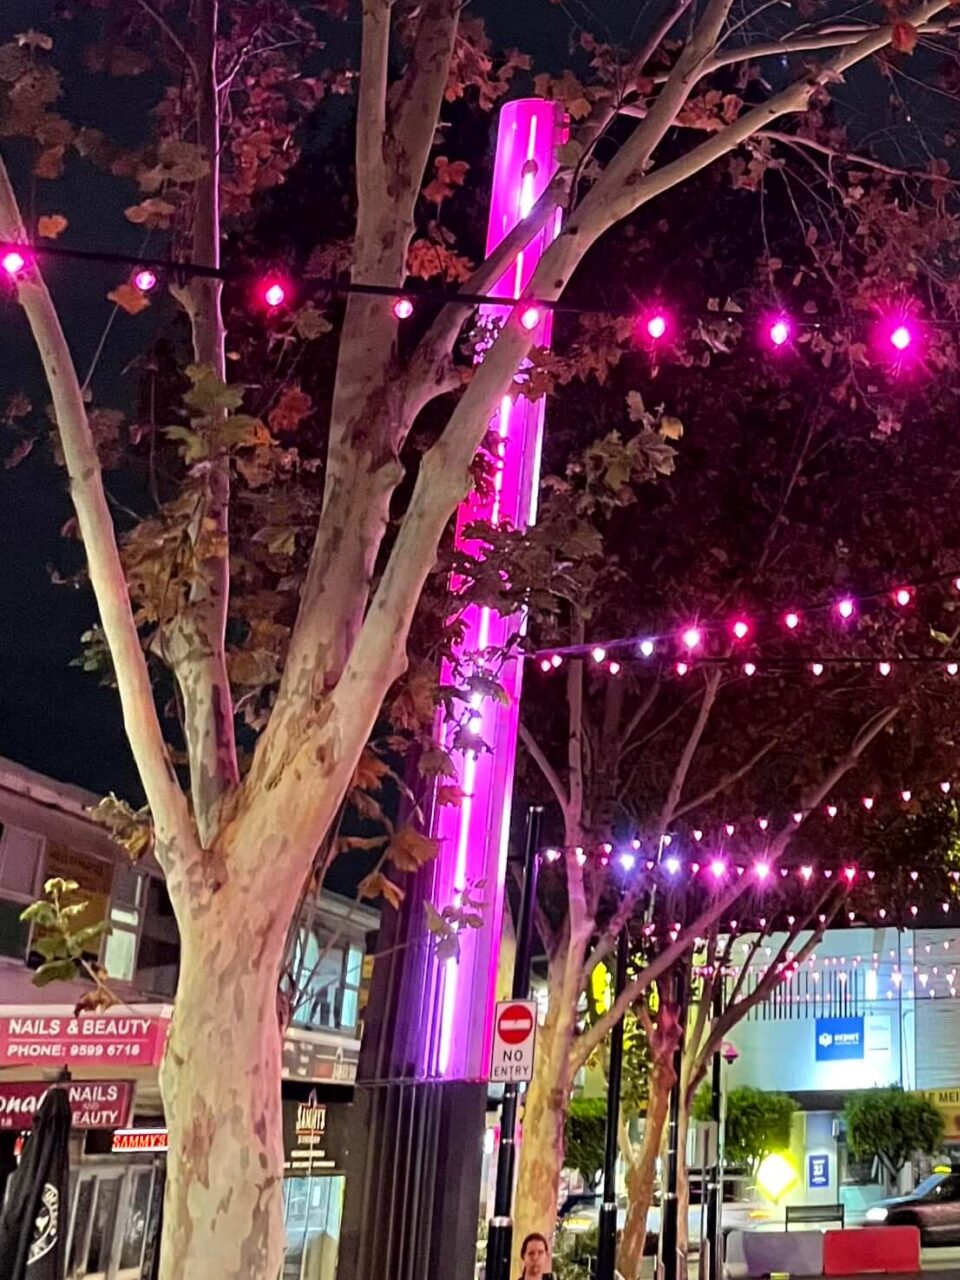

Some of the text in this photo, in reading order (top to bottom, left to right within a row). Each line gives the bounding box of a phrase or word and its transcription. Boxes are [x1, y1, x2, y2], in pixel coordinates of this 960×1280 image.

[9, 1019, 151, 1035] NAILS & BEAUTY
[7, 1044, 67, 1056] PHONE:
[503, 1049, 523, 1061] NO
[494, 1065, 529, 1077] ENTRY
[69, 1086, 118, 1102] NAILS
[73, 1111, 118, 1125] EAUTY
